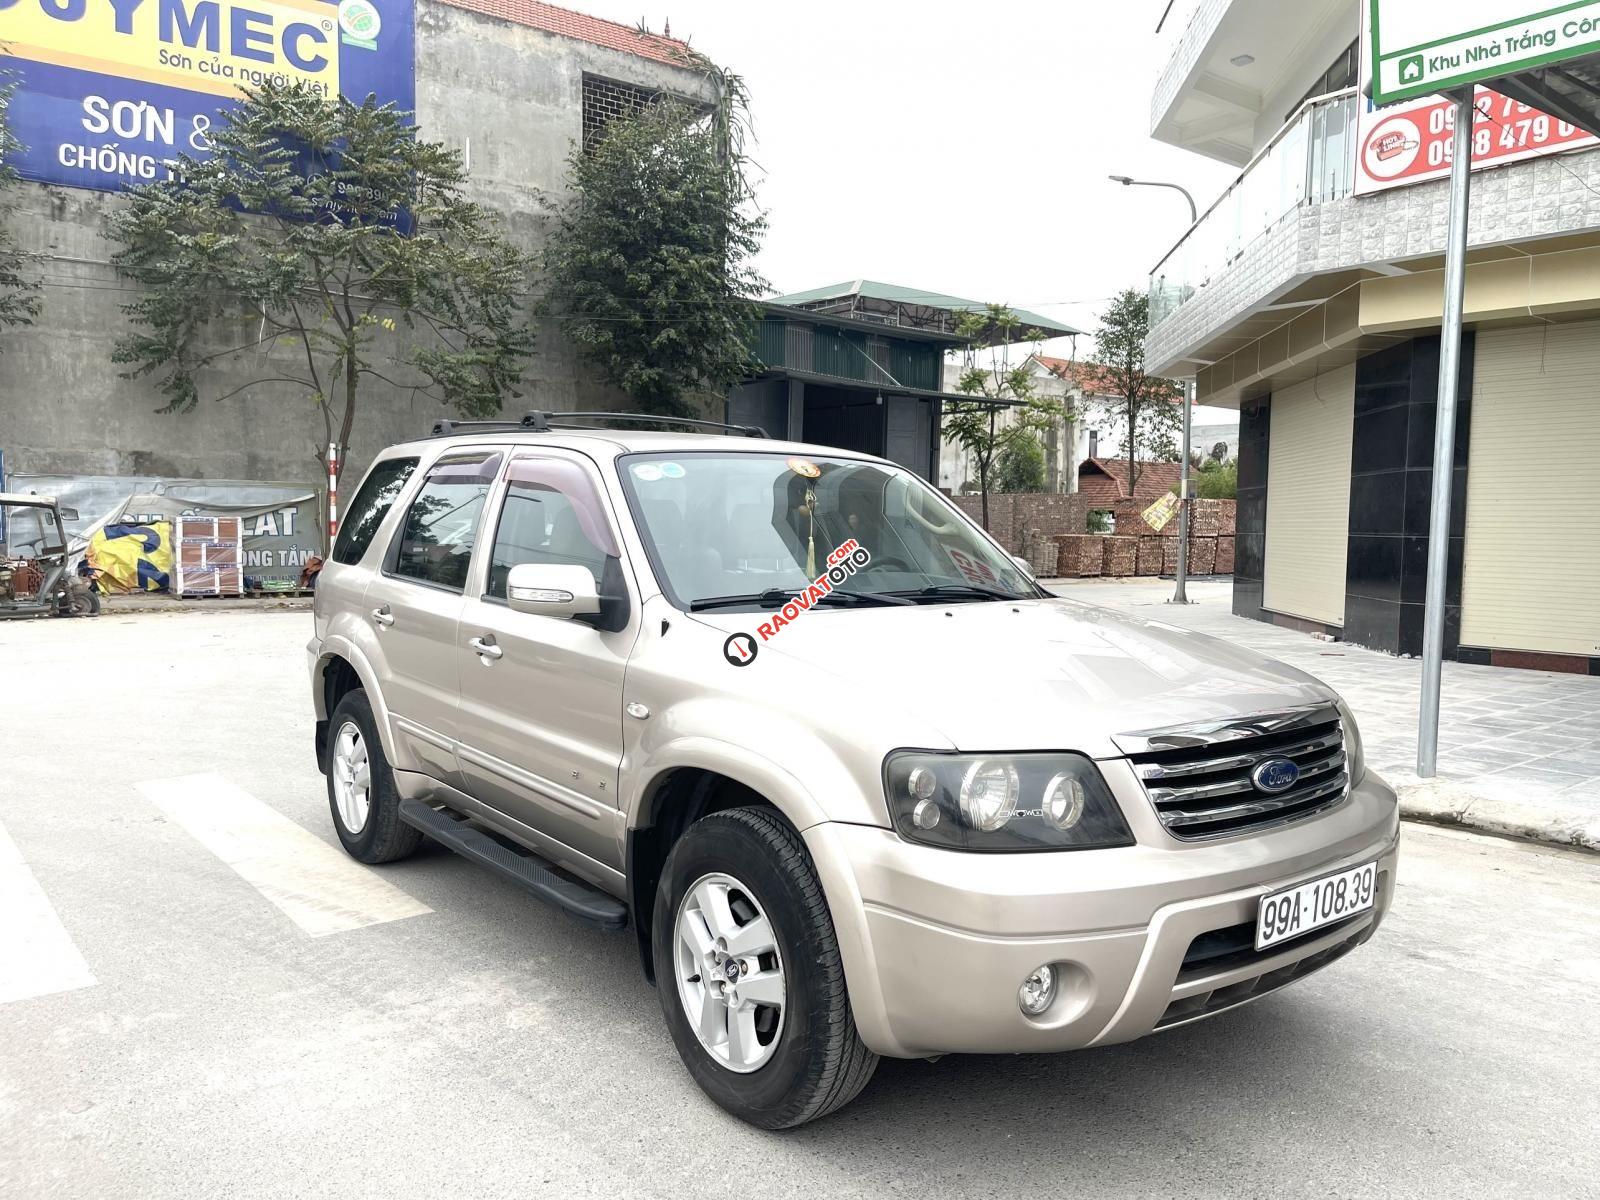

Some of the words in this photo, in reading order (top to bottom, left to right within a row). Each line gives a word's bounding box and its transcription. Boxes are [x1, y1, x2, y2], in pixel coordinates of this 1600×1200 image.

[0, 0, 329, 73] YMEC
[1429, 53, 1461, 74] Khu
[1466, 40, 1501, 64] Nhà
[1505, 29, 1556, 53] Trắng
[159, 48, 192, 70] Sơn
[198, 56, 234, 78] của
[82, 95, 174, 145] SƠN
[189, 114, 217, 151] &
[1429, 96, 1493, 134] 092
[58, 143, 156, 179] CHỐNG
[1428, 128, 1491, 166] 098
[1499, 114, 1550, 149] 479
